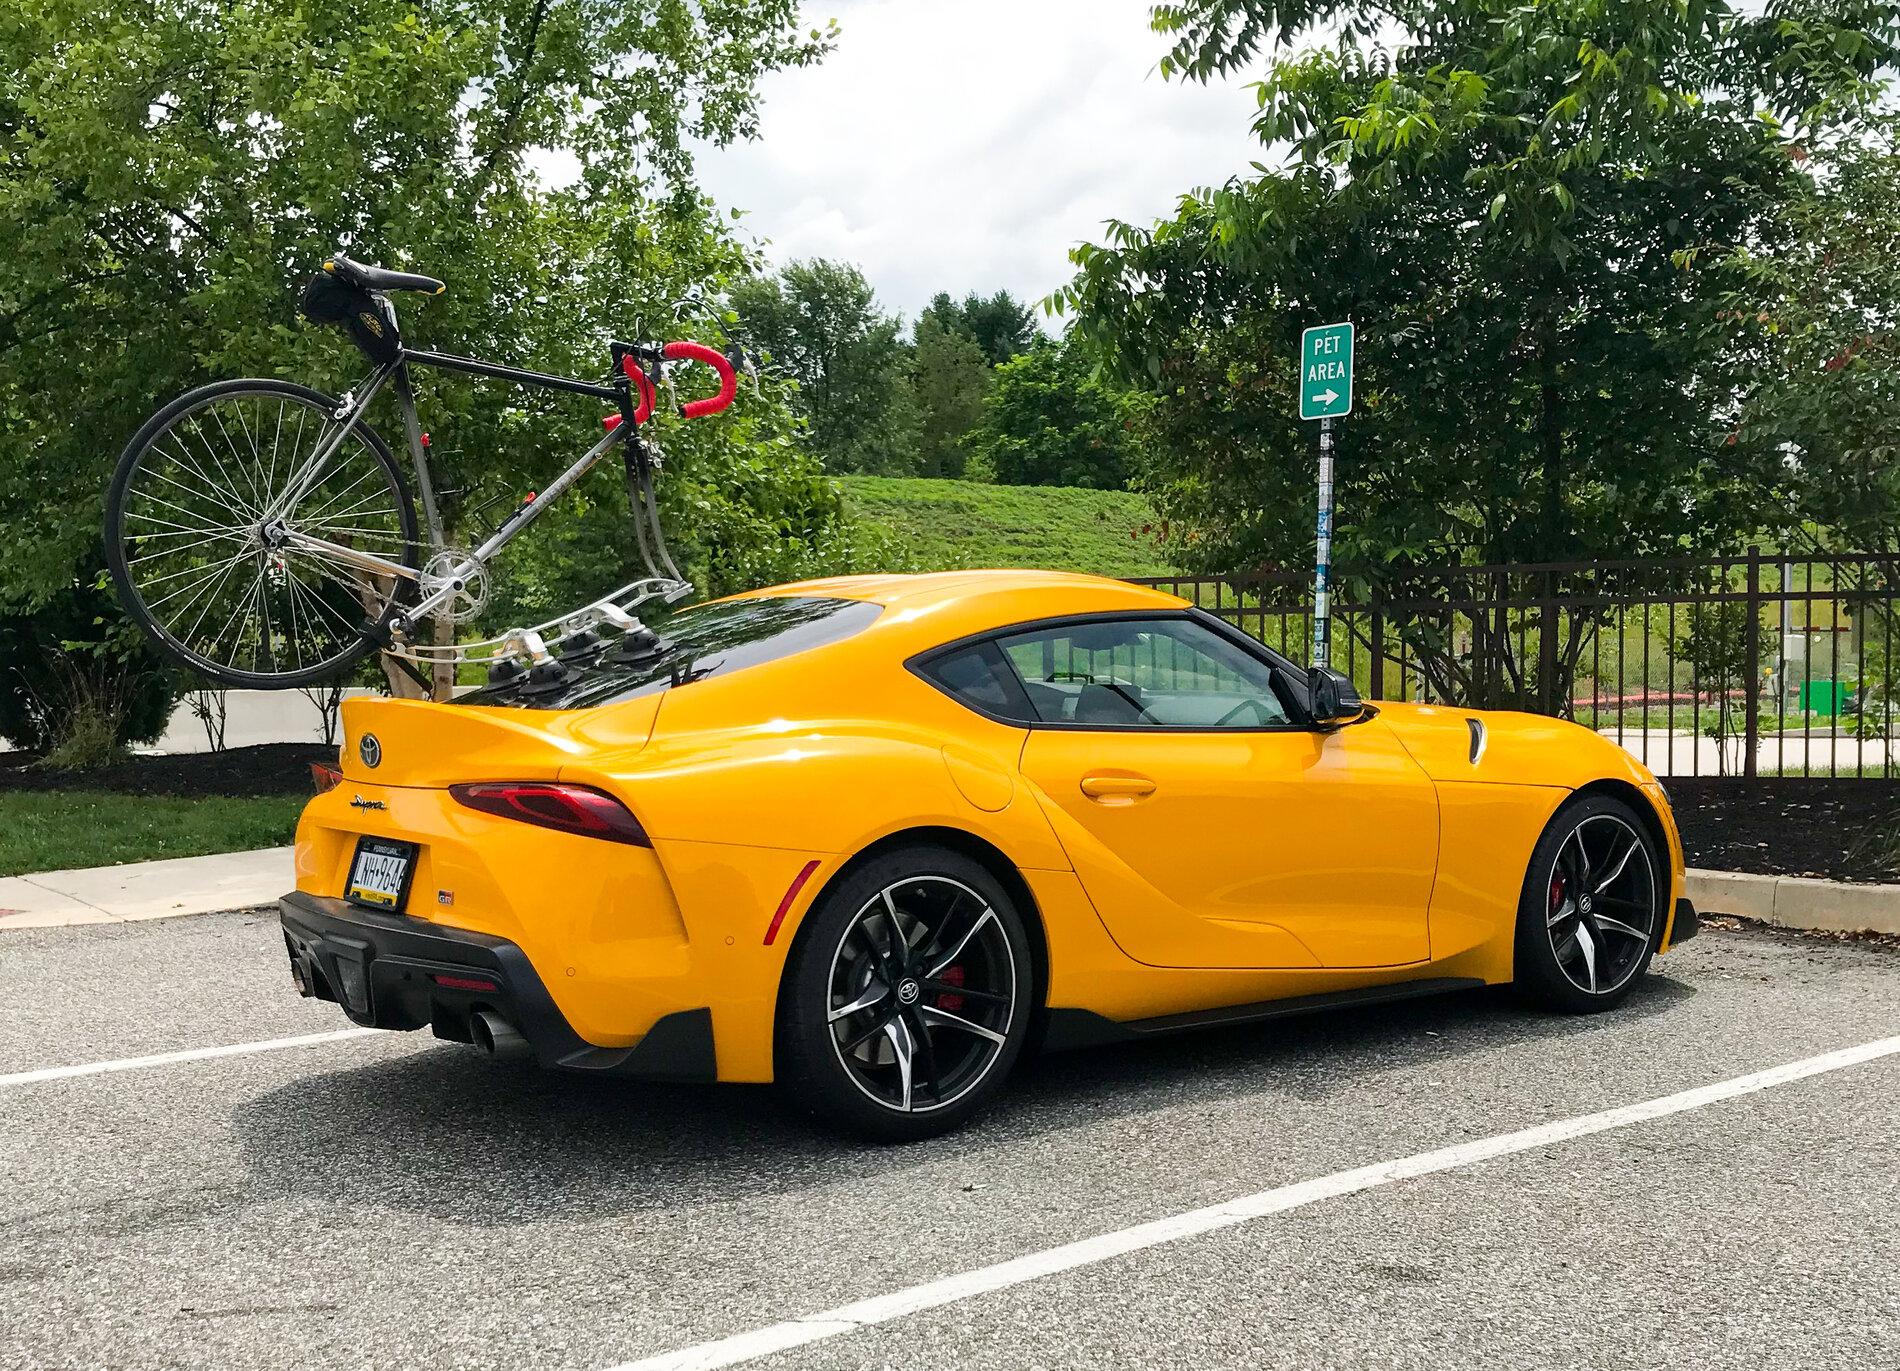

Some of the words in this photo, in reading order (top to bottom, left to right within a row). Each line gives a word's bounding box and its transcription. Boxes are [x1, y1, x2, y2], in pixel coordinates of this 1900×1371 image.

[1314, 336, 1341, 356] PET
[1308, 361, 1345, 382] AREA
[350, 794, 387, 816] Supra
[439, 895, 452, 904] GR
